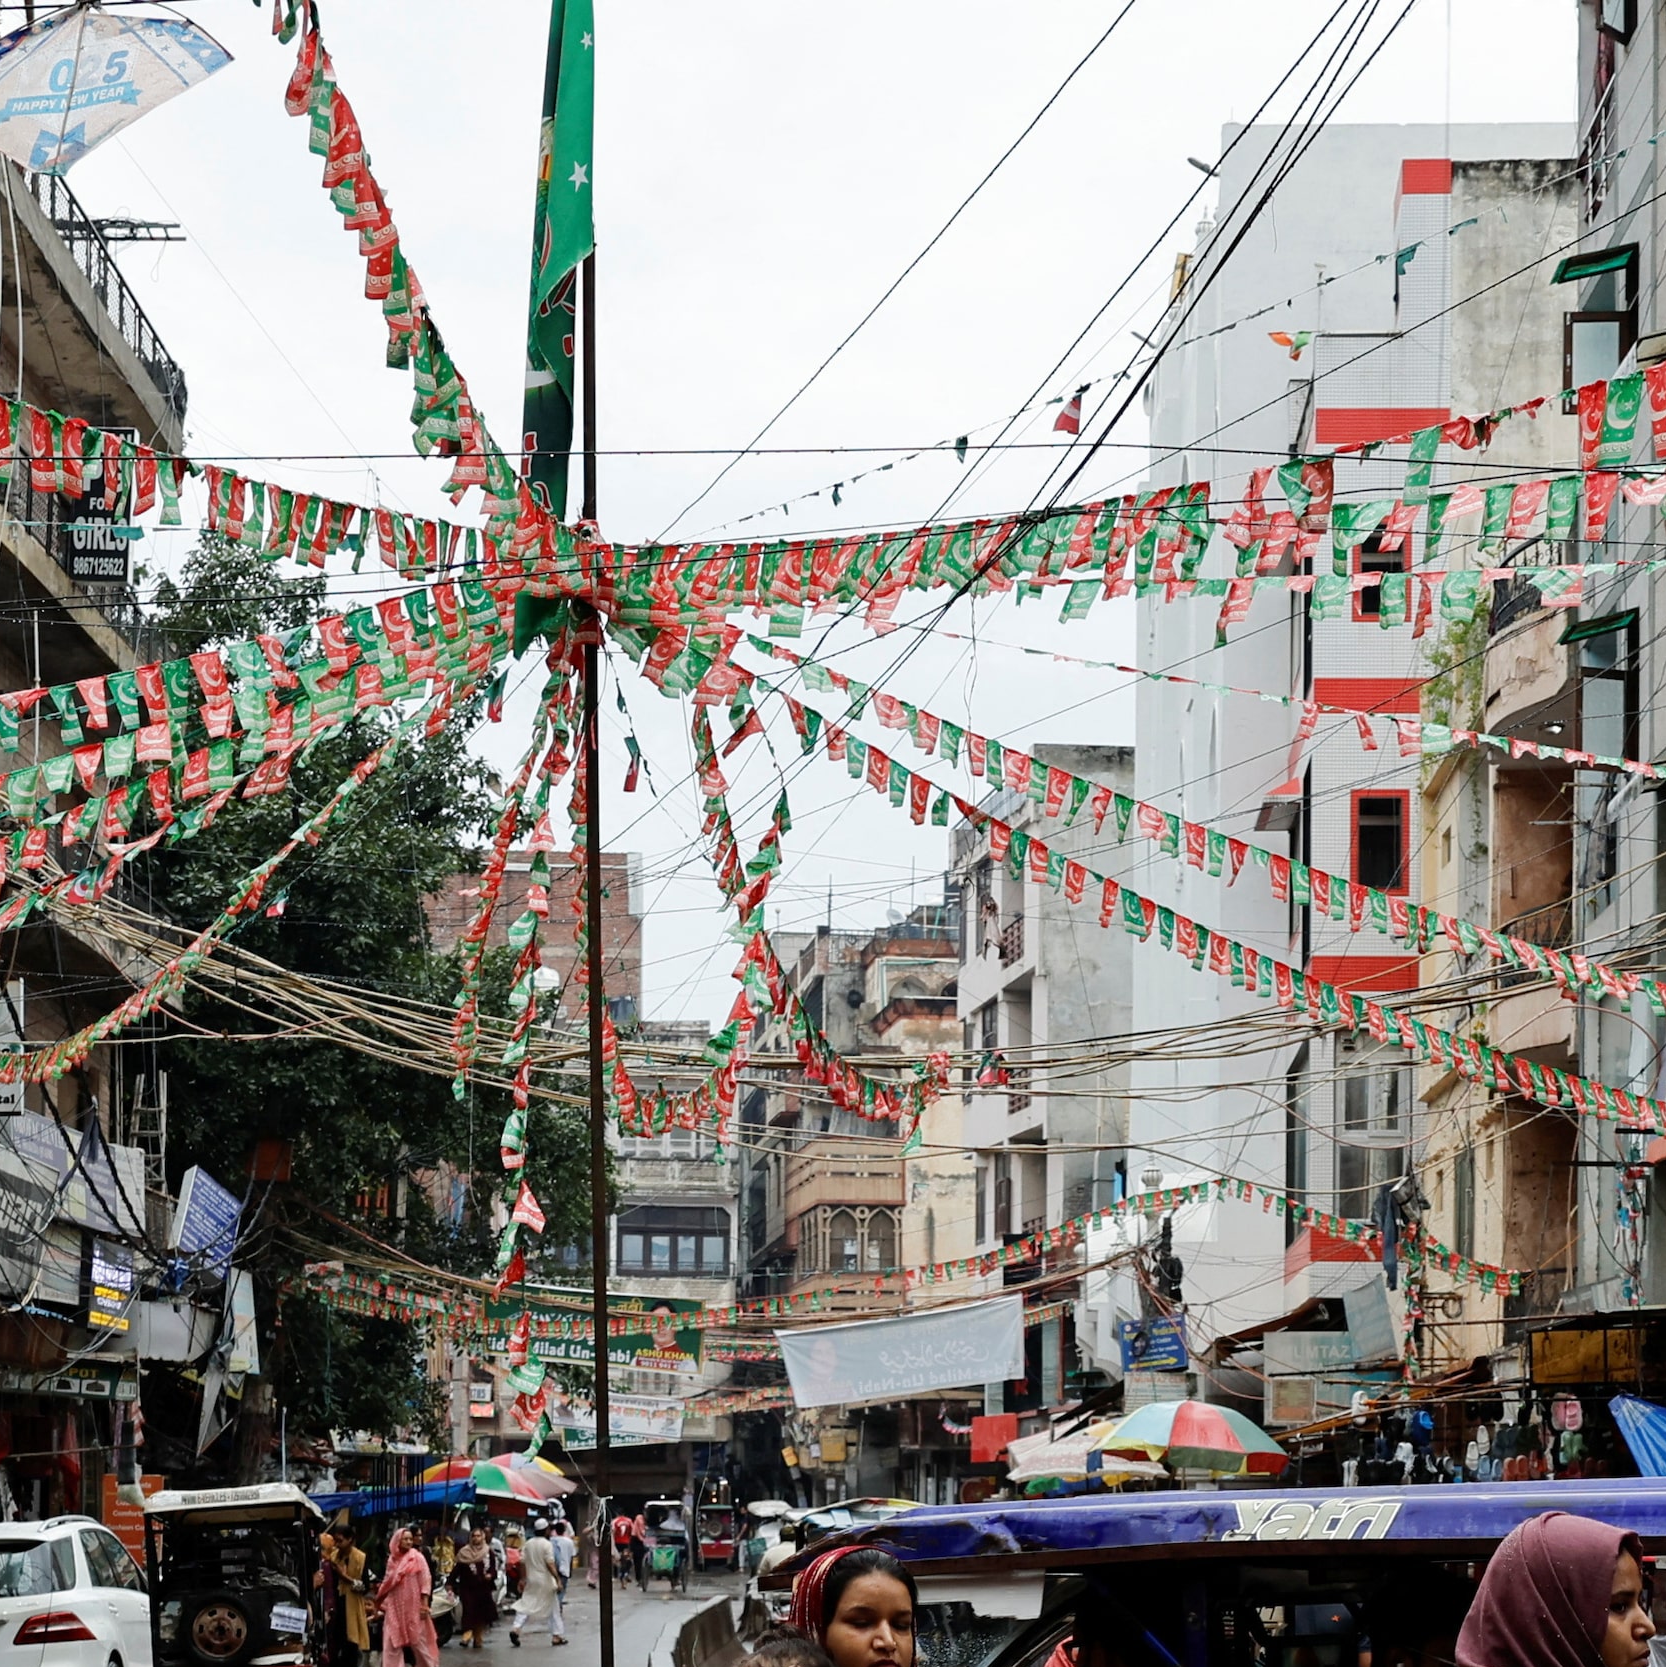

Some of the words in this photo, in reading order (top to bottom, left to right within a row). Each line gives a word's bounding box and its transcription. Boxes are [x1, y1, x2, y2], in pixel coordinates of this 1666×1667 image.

[12, 98, 56, 112] HAPPY
[60, 93, 88, 109] NEW
[92, 86, 124, 101] YEAR
[89, 496, 112, 511] FO
[73, 516, 128, 552] GIRLS
[73, 556, 124, 576] 9867125622
[569, 1344, 632, 1364] Un-abi
[634, 1347, 664, 1359] ASHU
[68, 1368, 100, 1379] POT
[1225, 1498, 1402, 1541] Yatri
